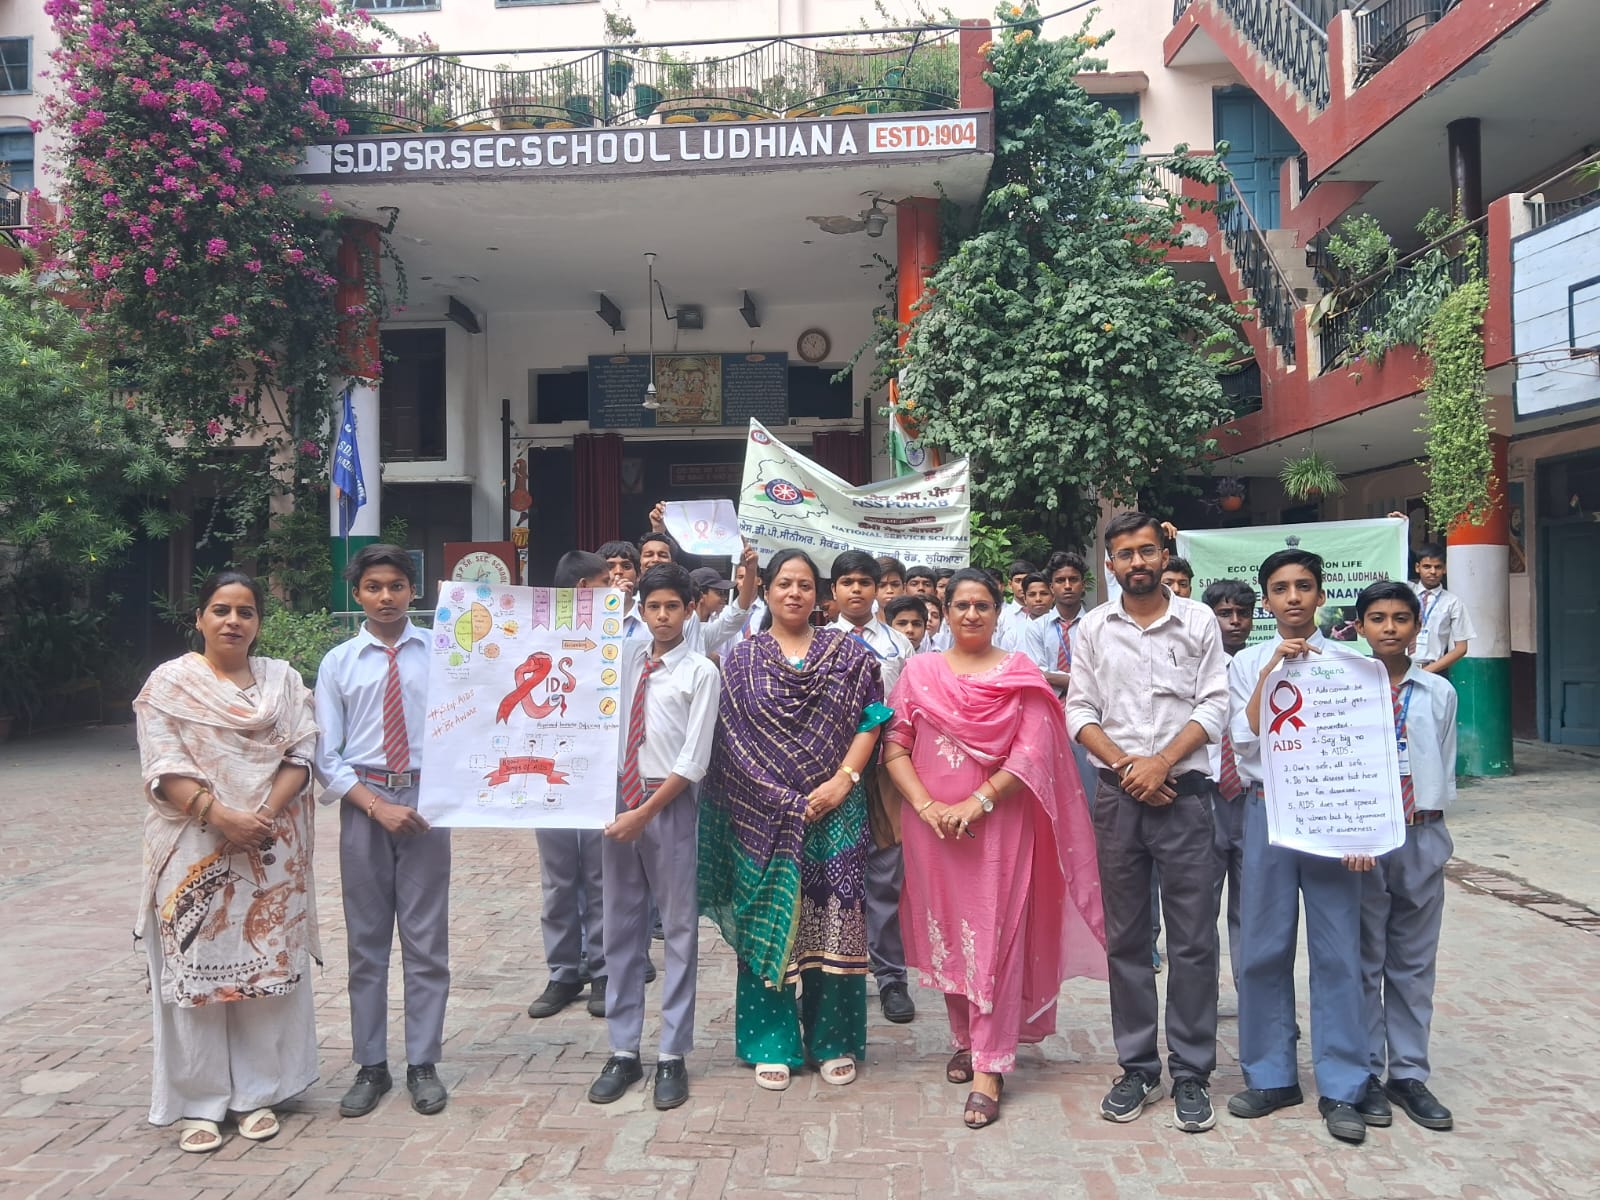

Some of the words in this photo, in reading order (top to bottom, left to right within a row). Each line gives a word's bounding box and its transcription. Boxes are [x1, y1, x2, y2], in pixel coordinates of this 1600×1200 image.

[680, 123, 858, 161] LUDHIANA
[852, 500, 884, 508] NSS
[886, 499, 948, 508] PUNJAB
[832, 524, 882, 538] NATIONAL
[884, 533, 926, 541] SERVICE
[1348, 570, 1390, 582] LUDHIANA
[1273, 739, 1302, 752] AIDS
[1321, 736, 1335, 746] Say
[1299, 800, 1315, 809] AIDS
